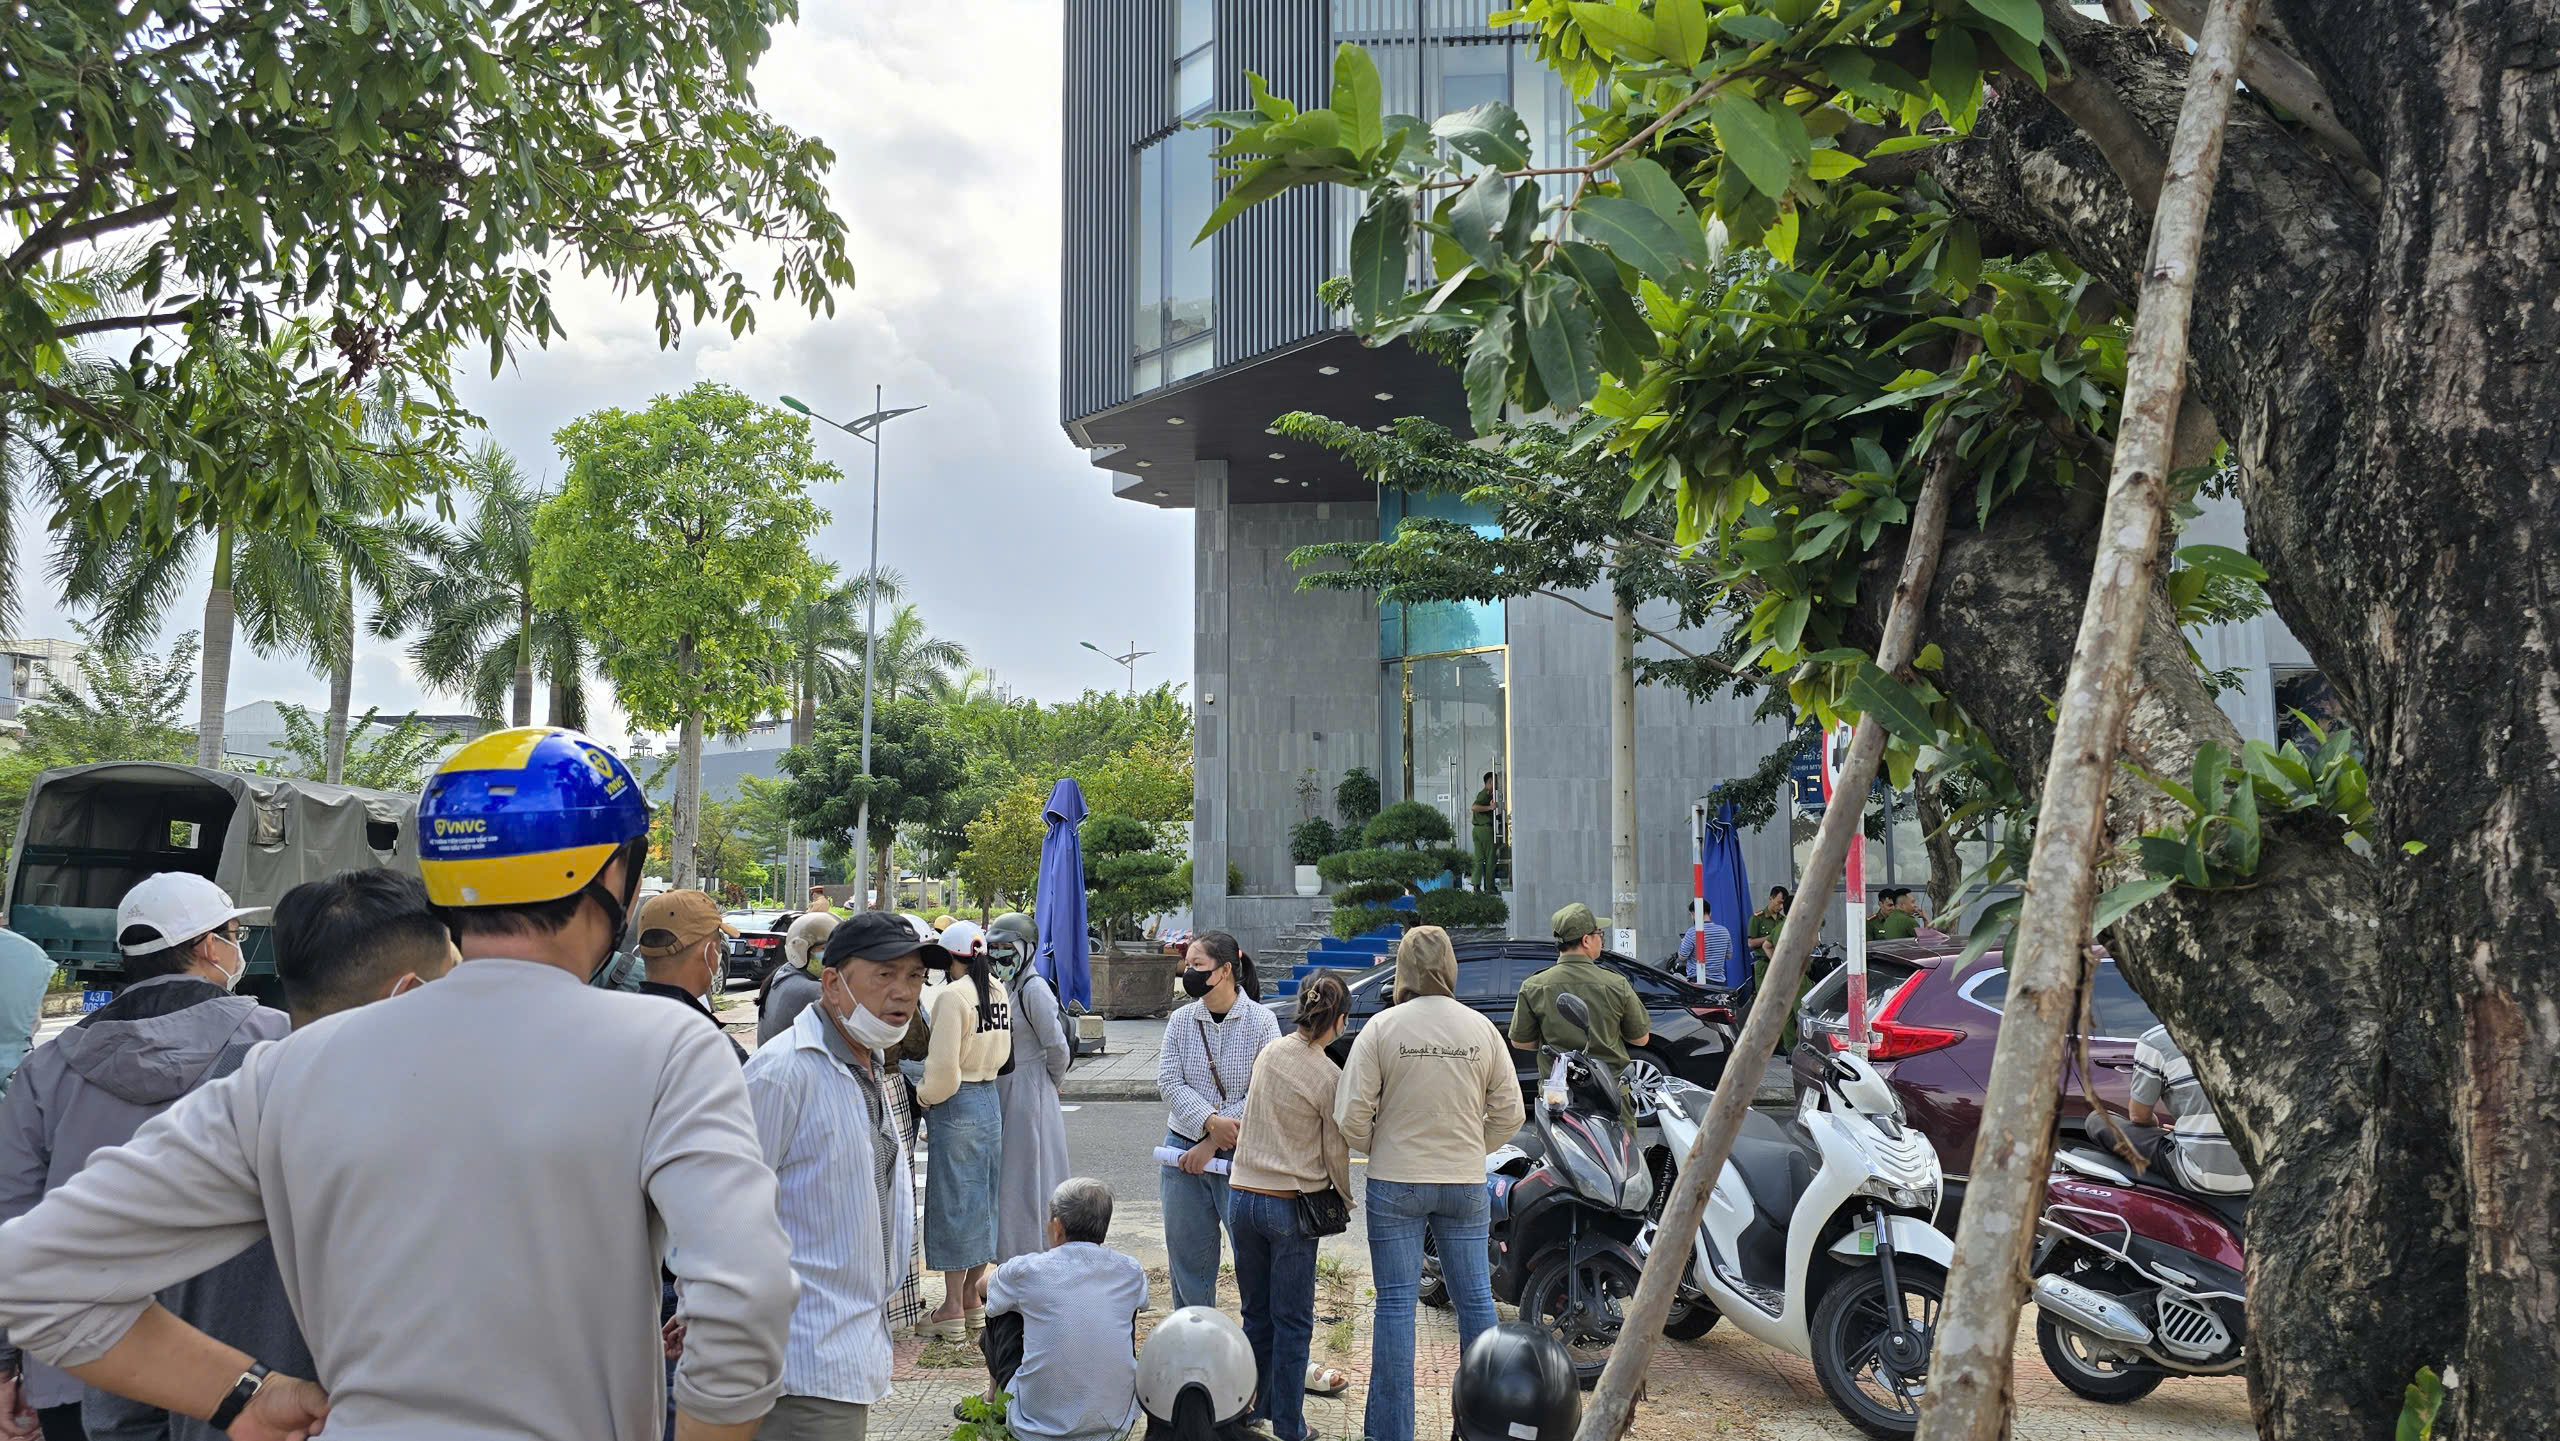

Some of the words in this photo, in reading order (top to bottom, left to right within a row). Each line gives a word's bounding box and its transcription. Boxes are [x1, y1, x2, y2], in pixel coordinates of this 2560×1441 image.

[602, 774, 625, 796] VNVC
[446, 819, 487, 834] VNVC
[1620, 931, 1630, 939] CS
[89, 992, 105, 1002] 43A
[83, 1002, 105, 1012] 006
[975, 1003, 1009, 1033] 192
[1399, 1041, 1430, 1059] through
[2064, 1185, 2112, 1198] LEAD
